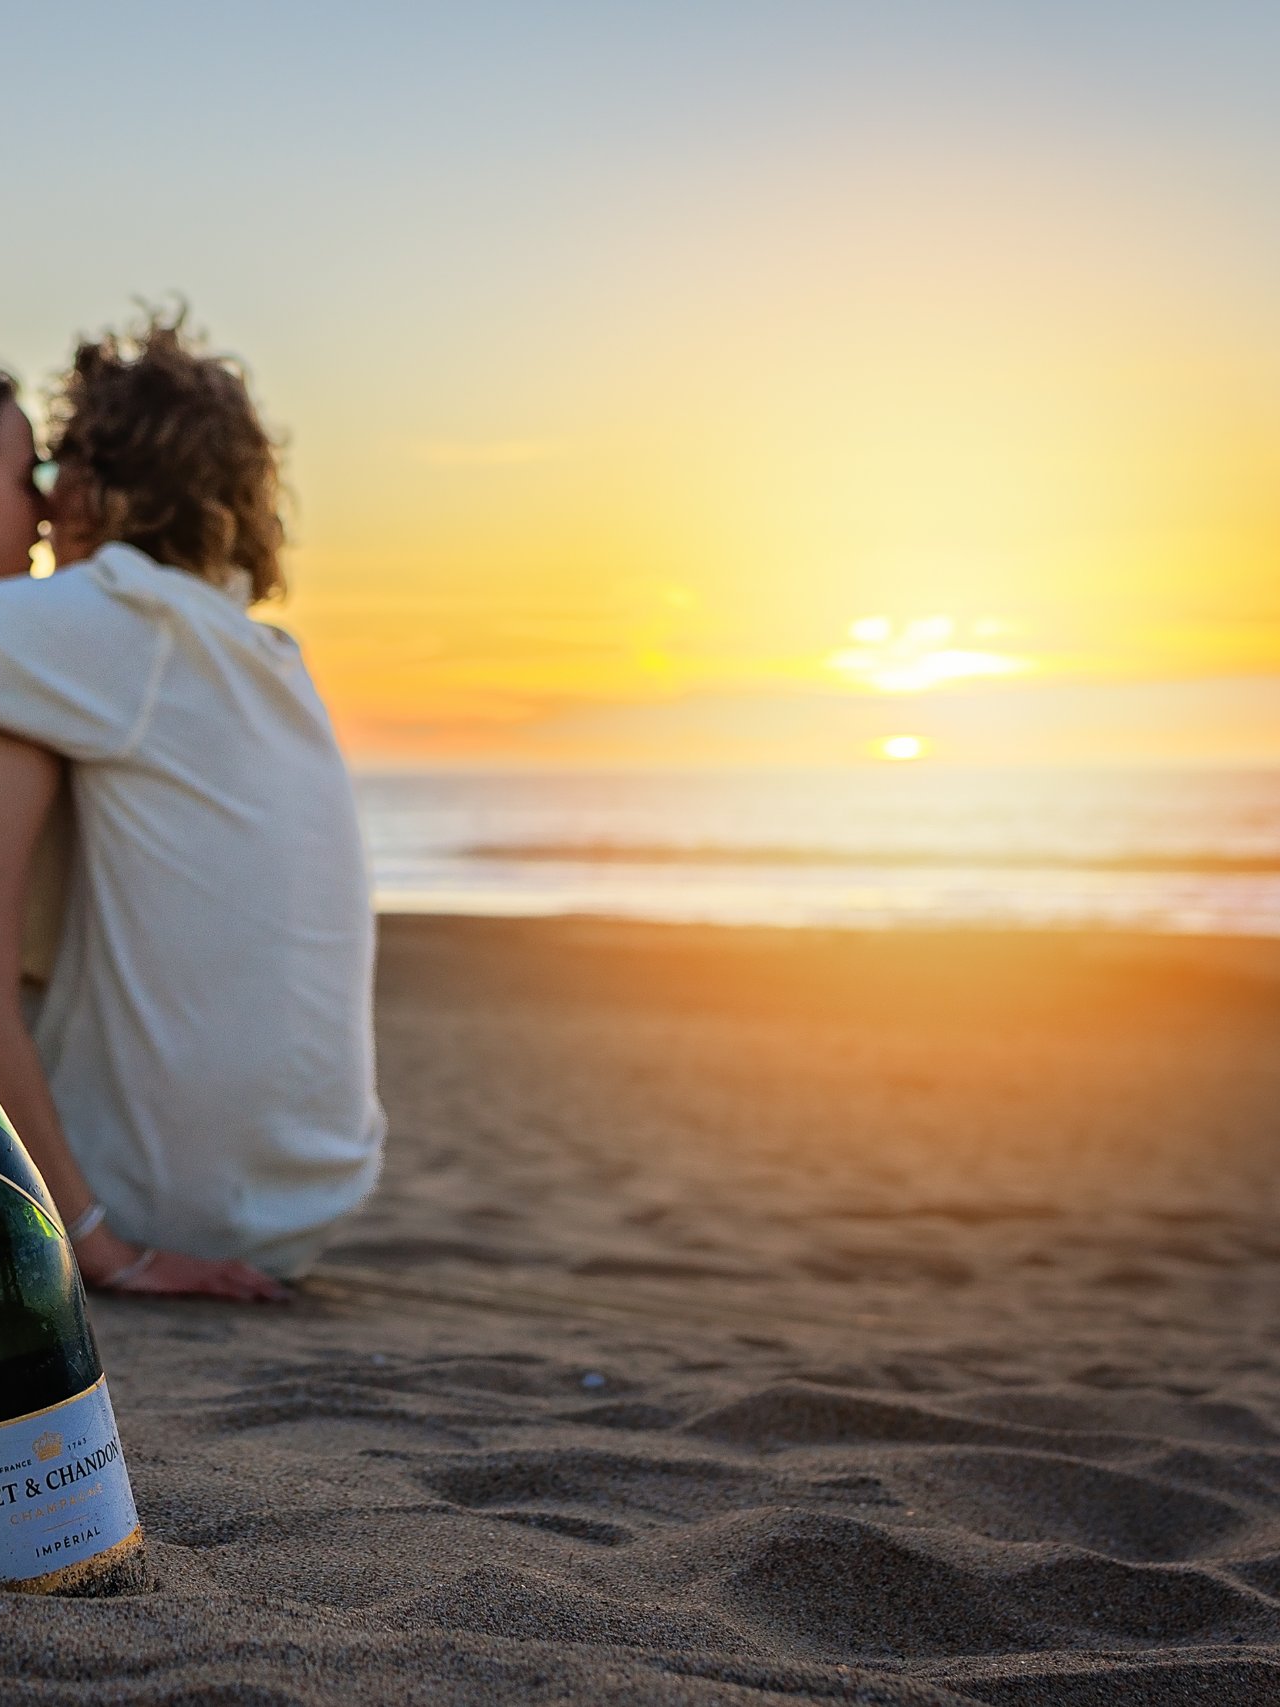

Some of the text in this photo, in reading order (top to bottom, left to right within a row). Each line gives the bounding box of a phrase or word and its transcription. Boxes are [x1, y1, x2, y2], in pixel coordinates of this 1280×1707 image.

[0, 1437, 87, 1474] FRANCE 1743
[25, 1477, 43, 1499] &
[45, 1436, 119, 1491] CHANDON
[35, 1526, 101, 1558] IMPÉRIAL
